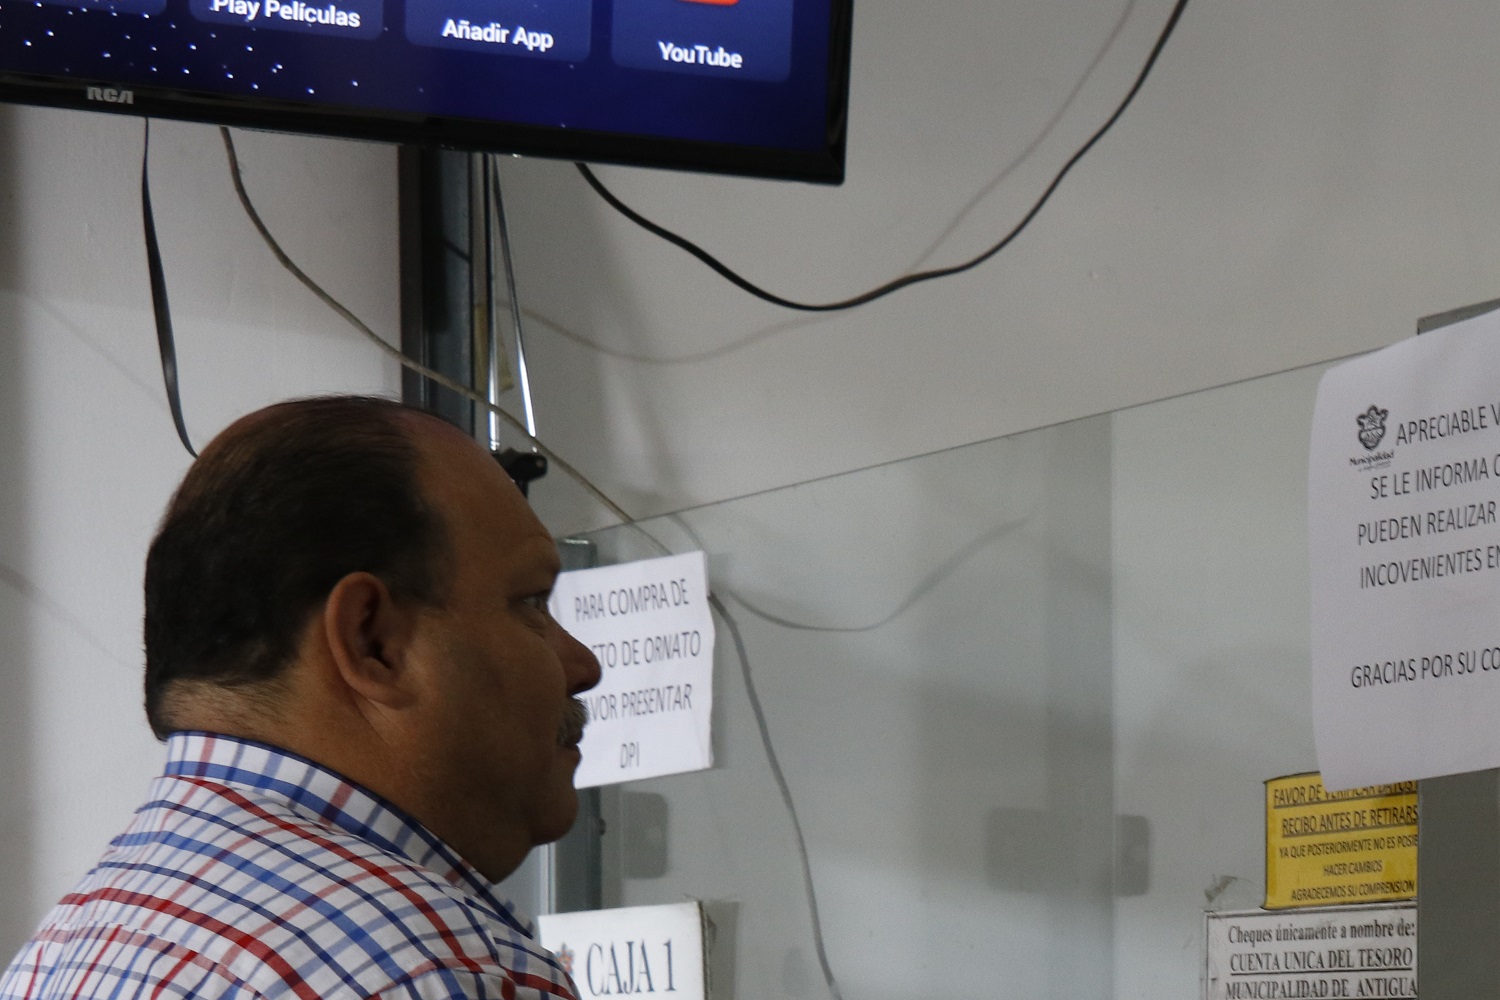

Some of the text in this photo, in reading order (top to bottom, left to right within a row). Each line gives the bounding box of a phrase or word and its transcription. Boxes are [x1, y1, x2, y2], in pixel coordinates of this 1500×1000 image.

[213, 0, 361, 28] Play Películas
[442, 19, 554, 52] Añadir App
[658, 41, 743, 69] YouTube
[87, 86, 134, 105] RCA
[1396, 405, 1487, 446] APRECIABLE
[1371, 476, 1388, 499] SE
[1394, 472, 1410, 496] LE
[1416, 453, 1489, 492] INFORMA
[1358, 514, 1421, 545] PUEDEN
[1427, 501, 1497, 534] REALIZAR
[1360, 548, 1482, 589] INCOVENIENTES
[575, 578, 690, 623] PARA COMPRA DE
[622, 639, 640, 666] DE
[644, 630, 701, 664] ORNATO
[1351, 658, 1416, 688] GRACIAS
[1422, 654, 1453, 679] POR
[1458, 650, 1476, 675] SU
[588, 684, 692, 721] VOR PRESENTAR
[620, 742, 640, 768] DPI
[1274, 786, 1306, 804] FAVOR
[1309, 784, 1322, 801] DE
[1282, 805, 1418, 835] RECIBO ANTES DE RETIRARS
[1290, 845, 1305, 858] QUE
[1307, 839, 1371, 857] POSTERIORMENTE
[1374, 837, 1385, 851] NO
[1387, 836, 1396, 849] ES
[1324, 860, 1383, 877] HACER CAMBIOS
[1291, 885, 1346, 901] AGRADECEMOS
[1348, 884, 1357, 897] SU
[1229, 918, 1415, 947] Cheques únicamente a nombre de:
[587, 938, 677, 997] CAJA 1
[1231, 947, 1413, 972] CUENTA UNICA DEL TESORO
[1225, 976, 1417, 1000] MUNICIPALIDAD DE ANTIGUA
